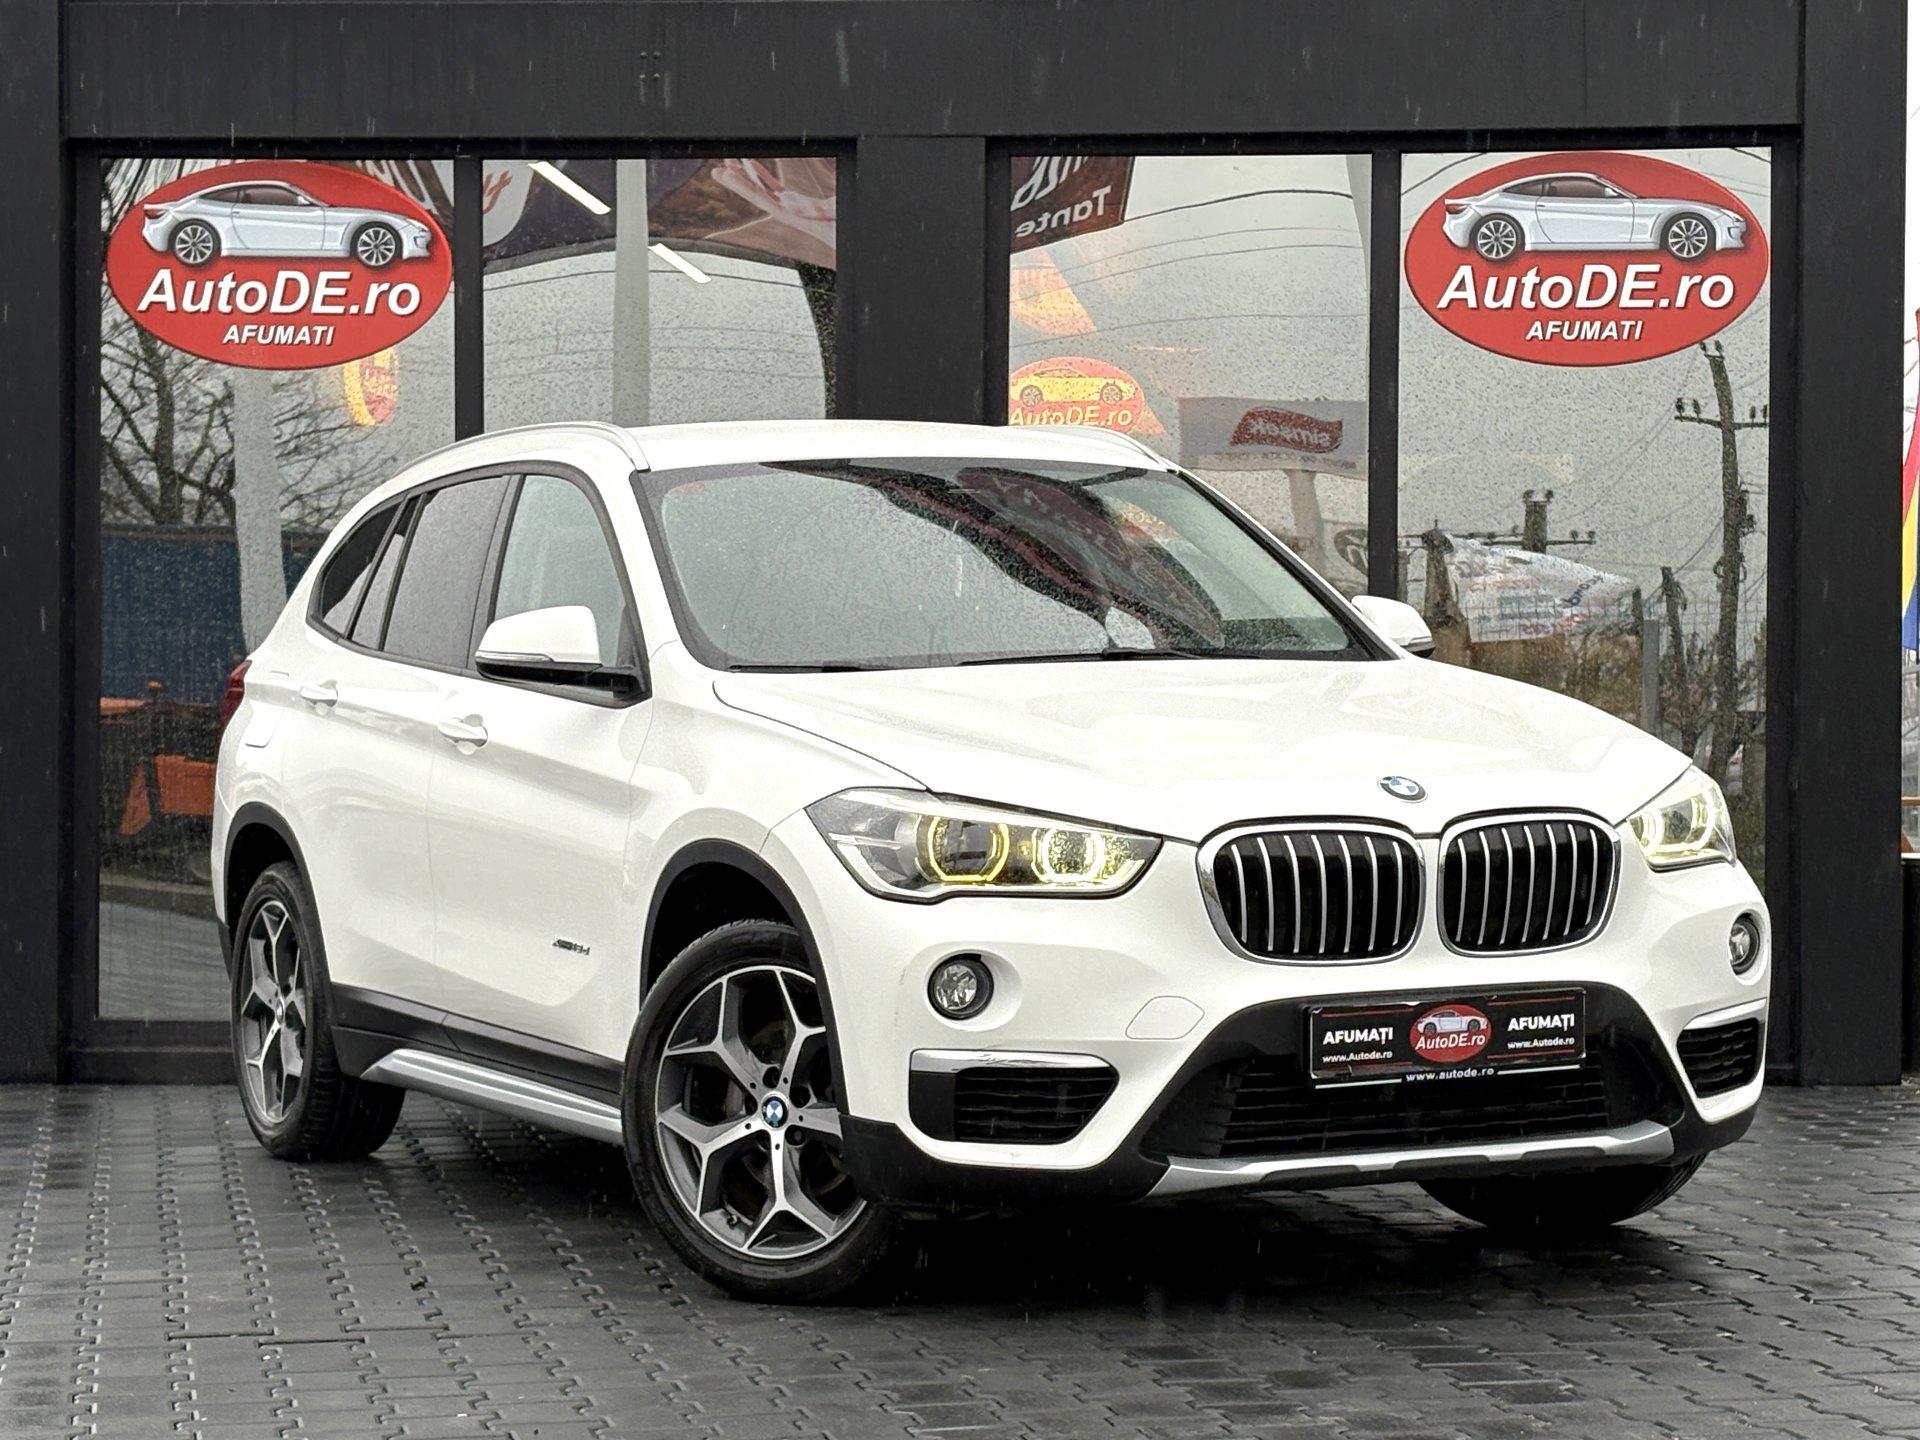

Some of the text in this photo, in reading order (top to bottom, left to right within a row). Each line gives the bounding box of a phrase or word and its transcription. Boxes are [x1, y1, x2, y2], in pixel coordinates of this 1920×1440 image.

[137, 269, 420, 315] AutoDE.ro
[1437, 263, 1734, 309] AutoDE.ro
[223, 324, 335, 345] AFUMATI
[1526, 320, 1642, 341] AFUMATI
[1415, 1032, 1486, 1051] AutoDE.ro
[1507, 1036, 1575, 1050] www.Autode.ro
[1322, 1050, 1393, 1064] www.Autode.ro
[1405, 1067, 1495, 1082] www.autode.ro
